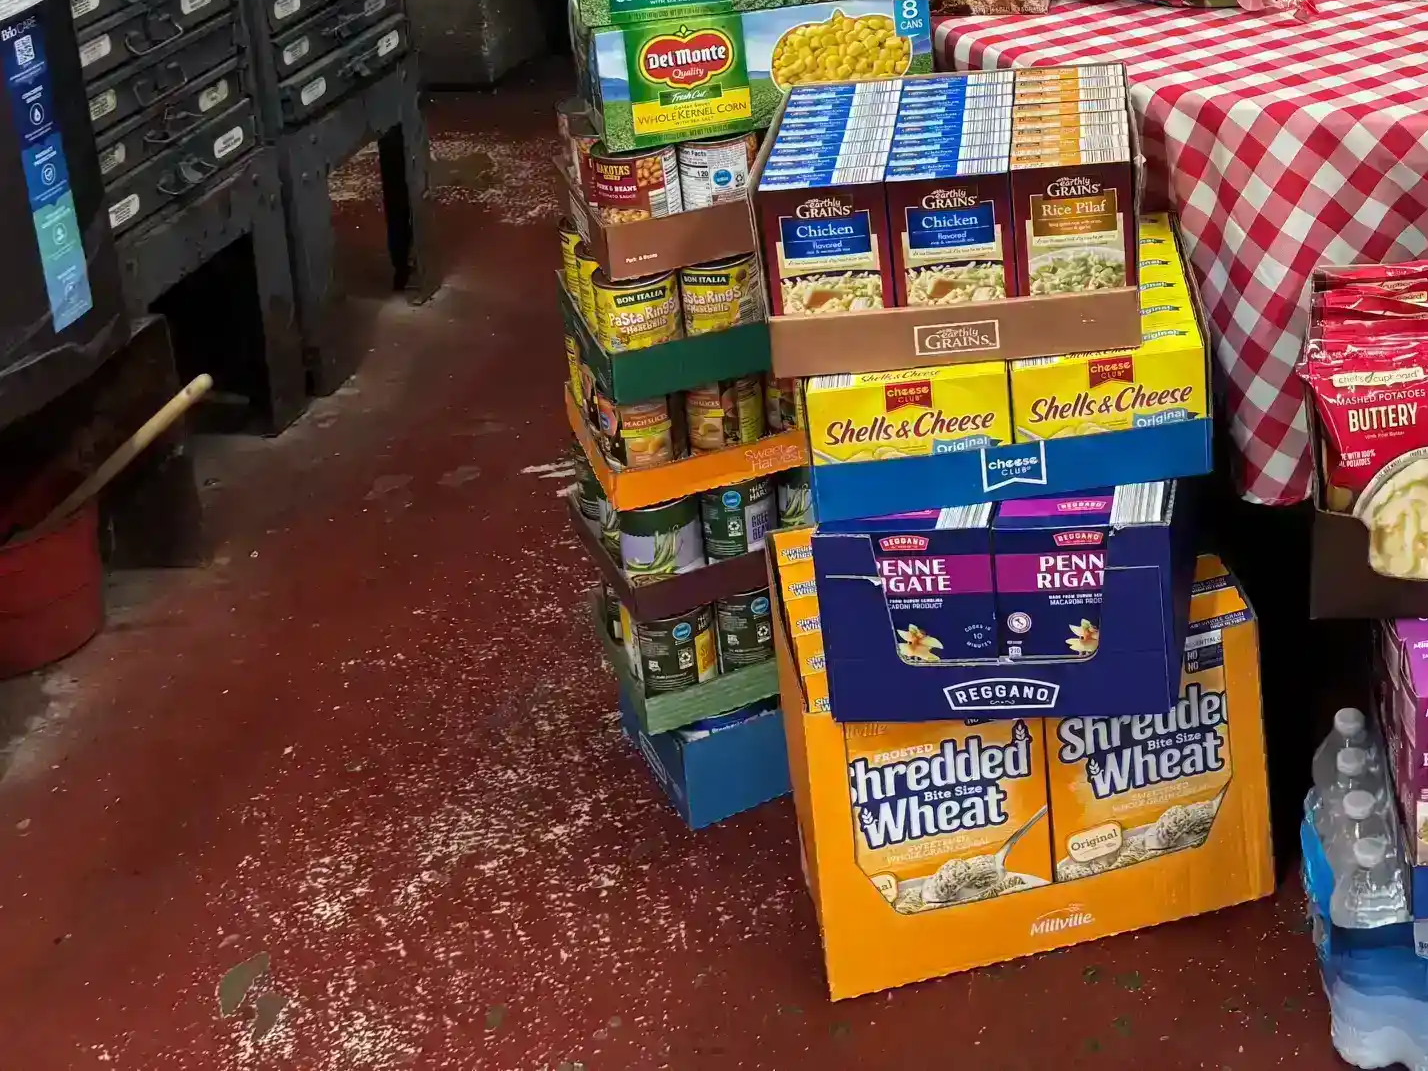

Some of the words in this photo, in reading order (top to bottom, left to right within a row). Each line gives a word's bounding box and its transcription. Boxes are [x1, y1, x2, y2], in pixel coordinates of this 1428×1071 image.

[902, 0, 918, 18] 8
[648, 51, 674, 68] Del
[676, 45, 726, 65] Monte
[638, 111, 675, 126] WHOLE
[676, 107, 715, 121] KERNEL
[717, 101, 747, 114] CORN
[923, 195, 976, 210] GRAINS
[1042, 201, 1071, 216] Rice
[1075, 200, 1106, 215] Pilaf
[796, 223, 854, 237] Chicken
[922, 214, 979, 229] Chicken
[616, 295, 635, 305] BON
[637, 290, 664, 302] ITALIA
[925, 333, 989, 350] GRAINS
[1028, 393, 1095, 424] Shells
[1097, 395, 1112, 412] &
[1114, 384, 1193, 413] Cheese
[1348, 404, 1418, 432] BUTTERY
[824, 420, 895, 447] Shells
[896, 422, 911, 438] &
[913, 410, 995, 437] Cheese
[745, 446, 784, 461] Sweet
[752, 450, 802, 470] Harvest
[1001, 466, 1027, 476] CLUB
[956, 687, 1050, 705] REGGANO
[1148, 737, 1172, 751] Bite
[1176, 731, 1201, 745] Size
[1095, 734, 1225, 798] Wheat
[924, 788, 952, 803] Bite
[956, 783, 983, 798] Size
[865, 788, 1007, 849] Wheat
[1070, 827, 1119, 851] Original
[1030, 911, 1092, 937] Millville
